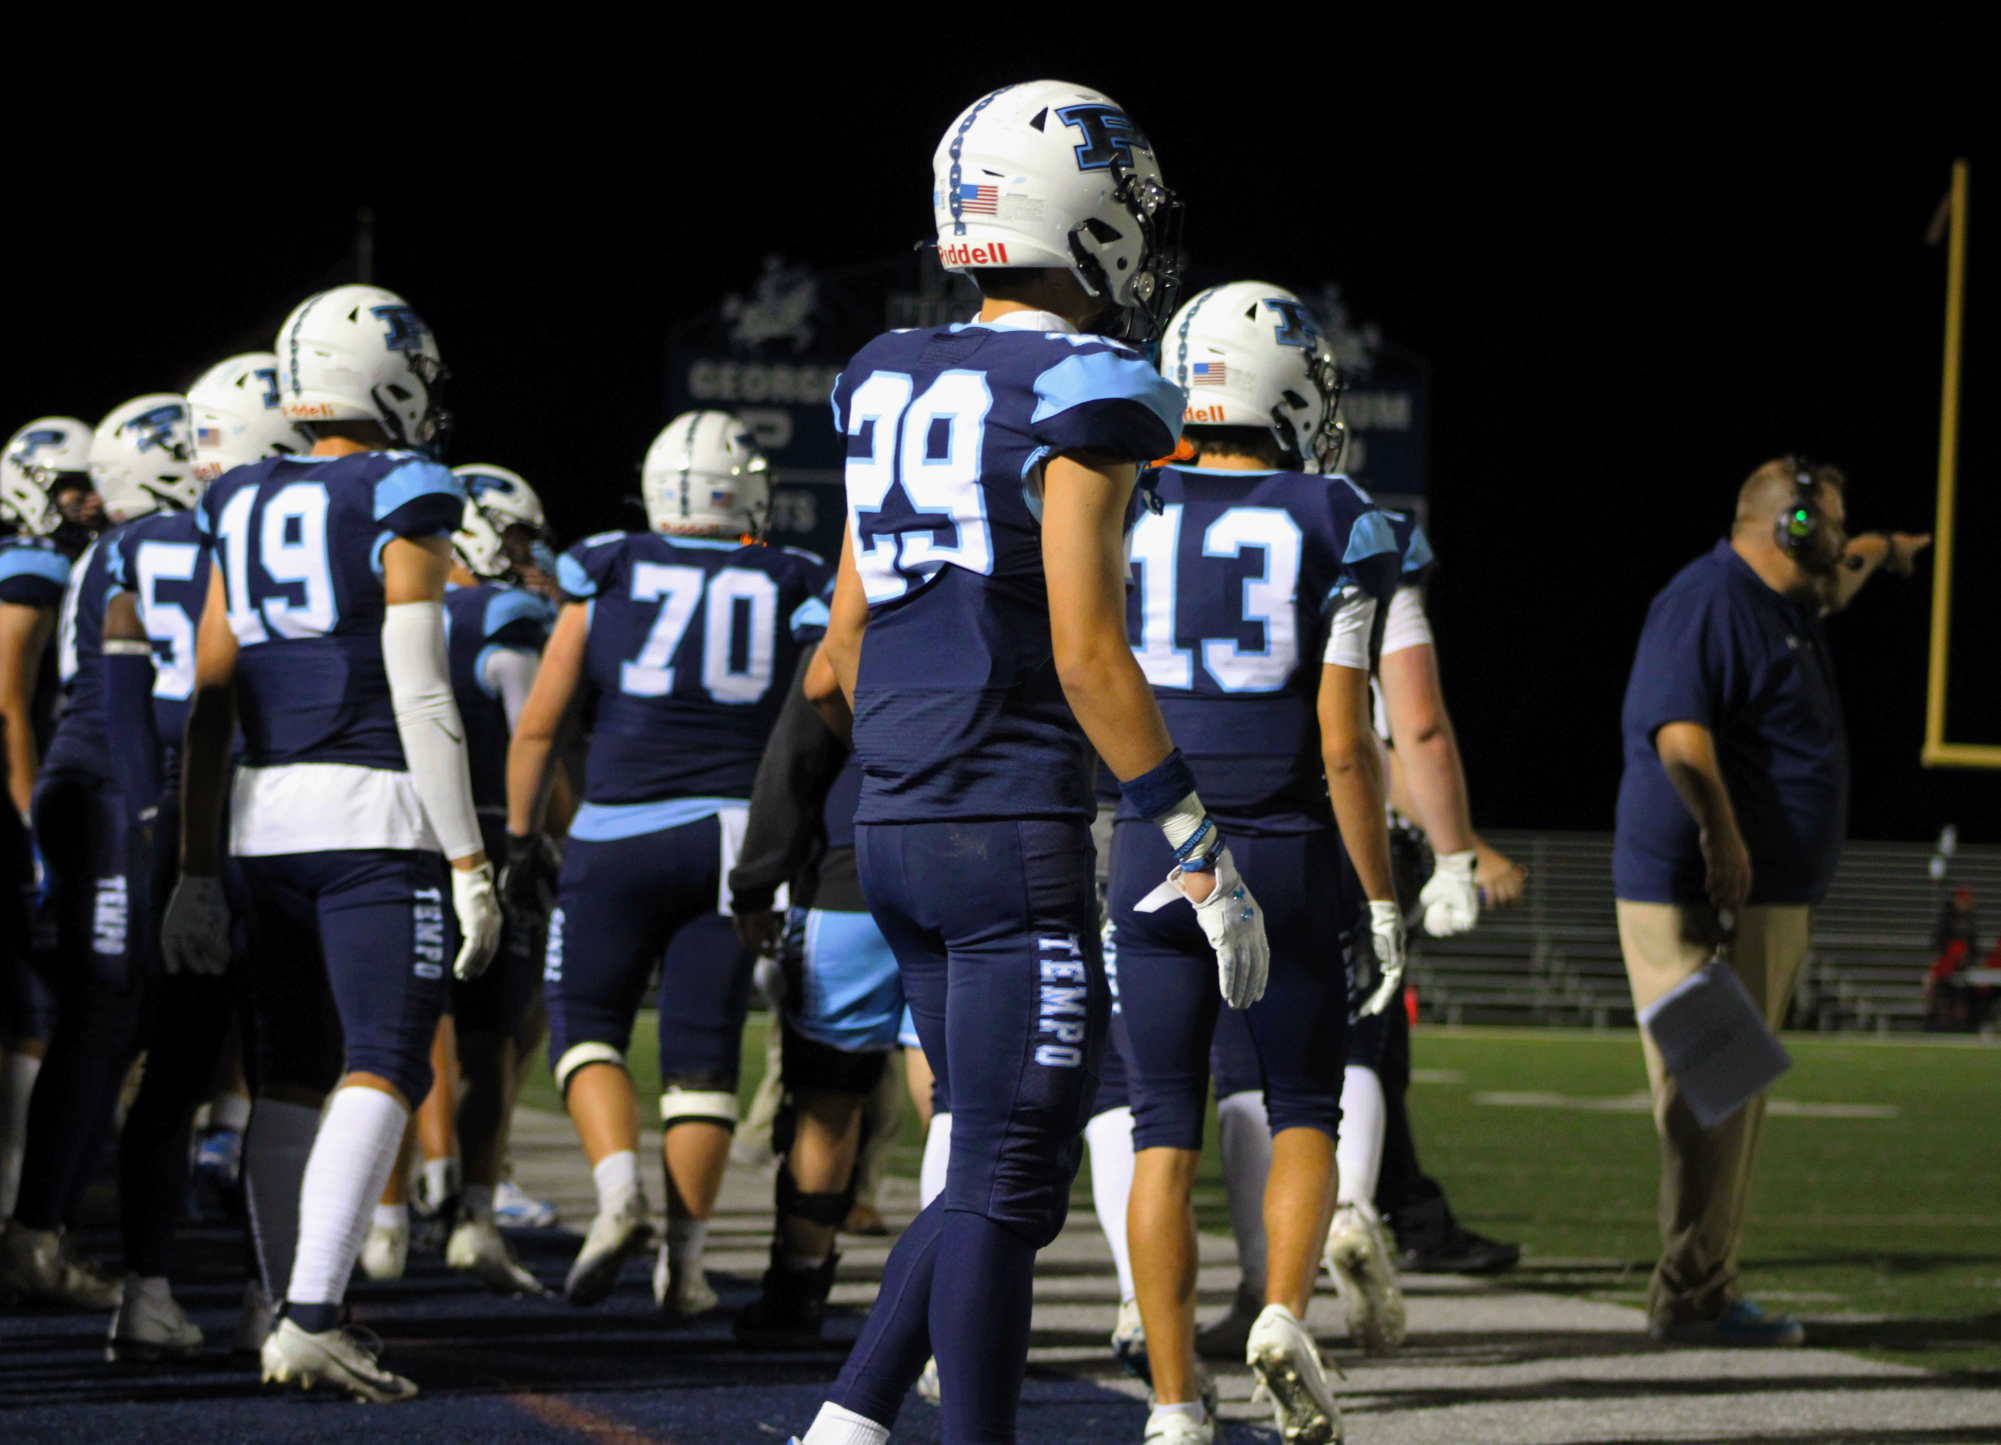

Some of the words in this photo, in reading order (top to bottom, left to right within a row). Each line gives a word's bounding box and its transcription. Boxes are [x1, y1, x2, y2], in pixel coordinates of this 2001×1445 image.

[845, 368, 994, 604] 29
[136, 540, 200, 700] 5
[215, 482, 340, 647] 19
[620, 561, 778, 704] 70
[1129, 503, 1303, 693] 13
[1180, 825, 1209, 856] FOOTBALL
[413, 886, 444, 980] TEMPO
[1034, 933, 1087, 1068] TEMPO
